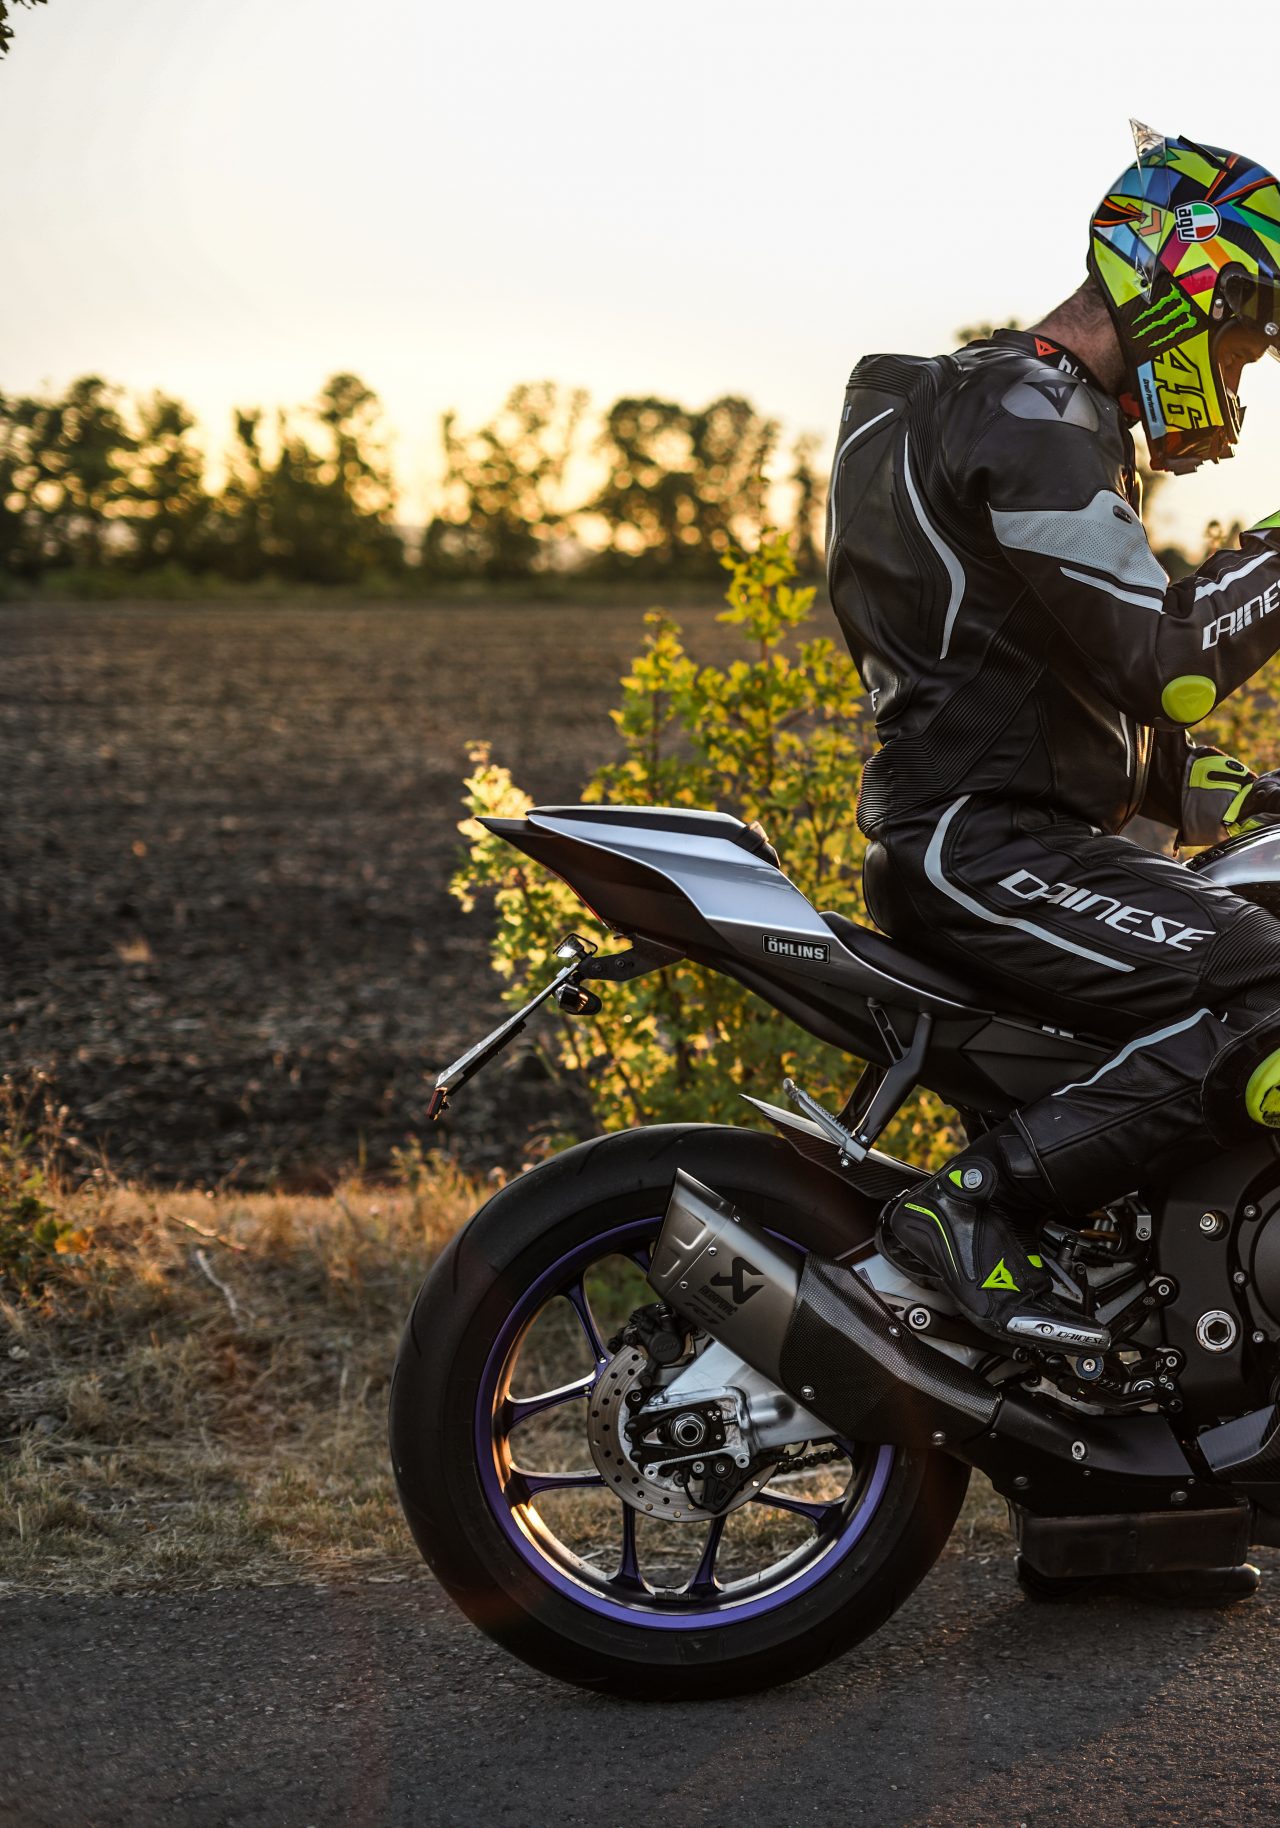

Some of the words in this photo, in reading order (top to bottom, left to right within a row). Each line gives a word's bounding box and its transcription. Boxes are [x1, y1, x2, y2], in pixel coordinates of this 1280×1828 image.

[1177, 207, 1195, 241] agv
[1153, 346, 1212, 430] 46
[997, 868, 1216, 952] DAINESE
[768, 937, 824, 960] ÖHLINS
